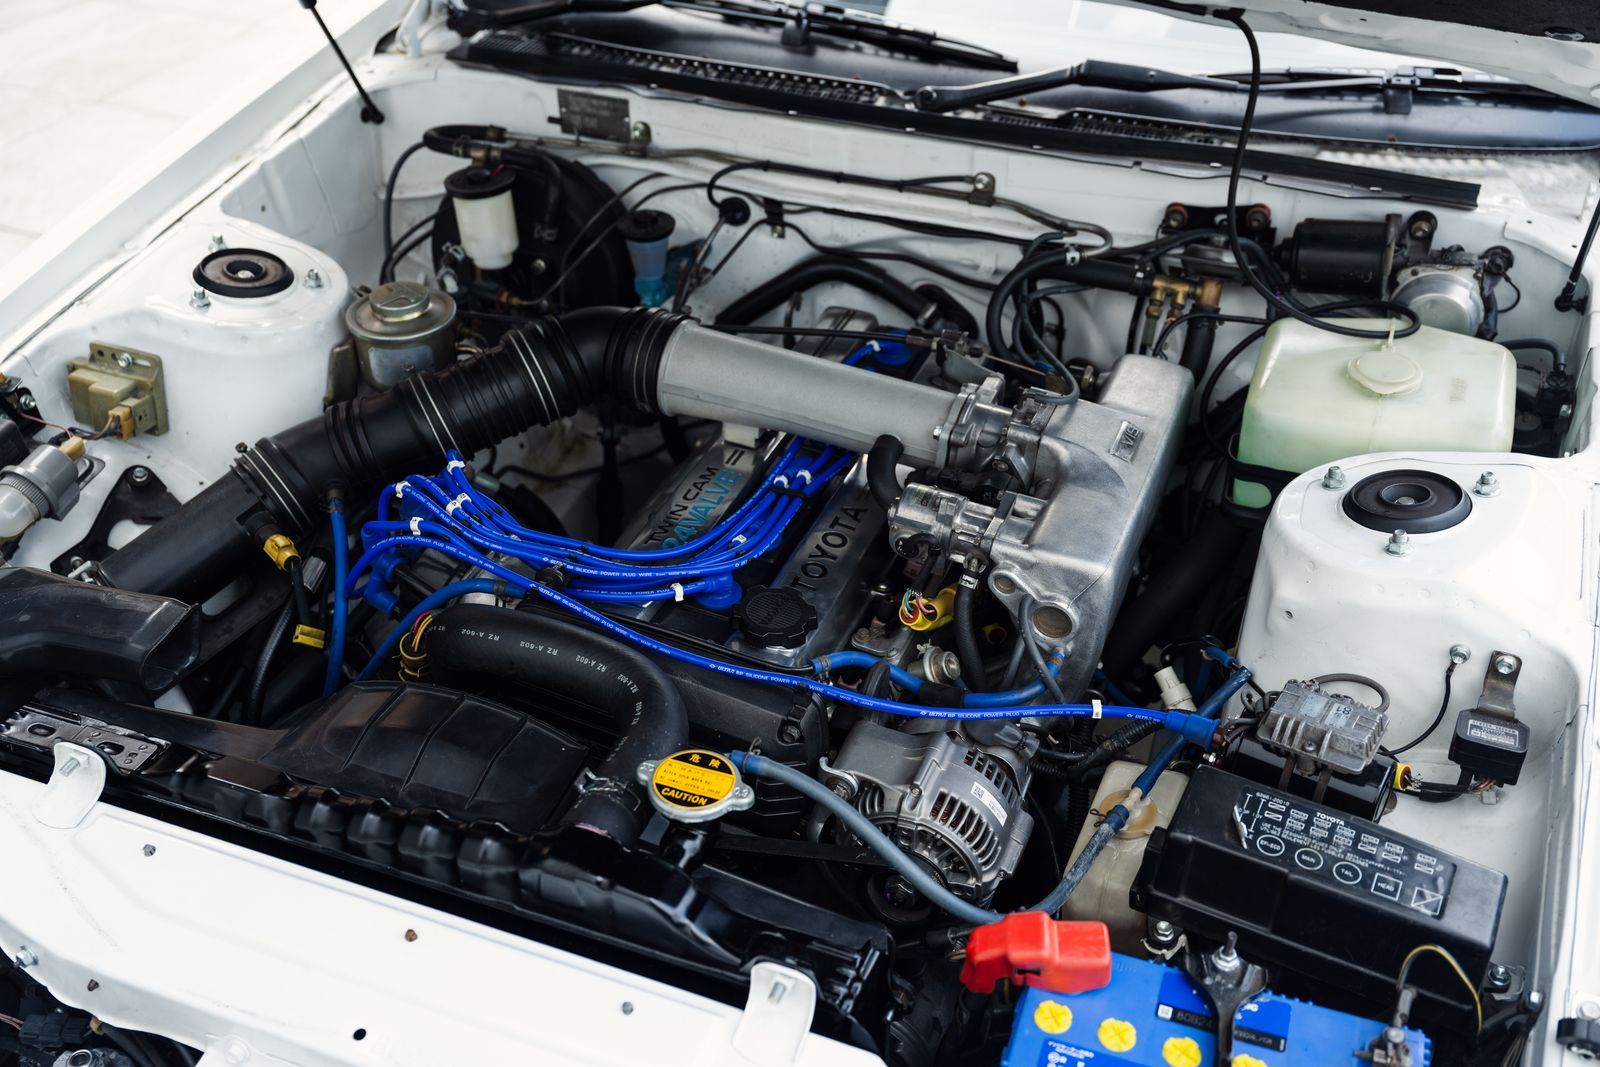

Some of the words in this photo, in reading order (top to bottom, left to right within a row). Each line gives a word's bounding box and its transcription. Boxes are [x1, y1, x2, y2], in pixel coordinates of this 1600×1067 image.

[644, 503, 688, 544] TWIN
[682, 466, 720, 501] CAM
[790, 507, 869, 591] TOYOTA
[576, 567, 598, 575] SILICONE
[583, 610, 600, 622] POWER
[601, 619, 614, 629] PLUG
[488, 633, 499, 641] RZ
[547, 647, 558, 656] RZ
[597, 663, 607, 673] RZ
[745, 672, 769, 680] SILICONE
[770, 676, 790, 684] POWER
[809, 684, 824, 692] WIRE
[661, 787, 708, 805] CAUTION
[1316, 812, 1345, 826] TOYOTA
[1301, 854, 1316, 863] MAIN
[1377, 881, 1395, 892] HEAD
